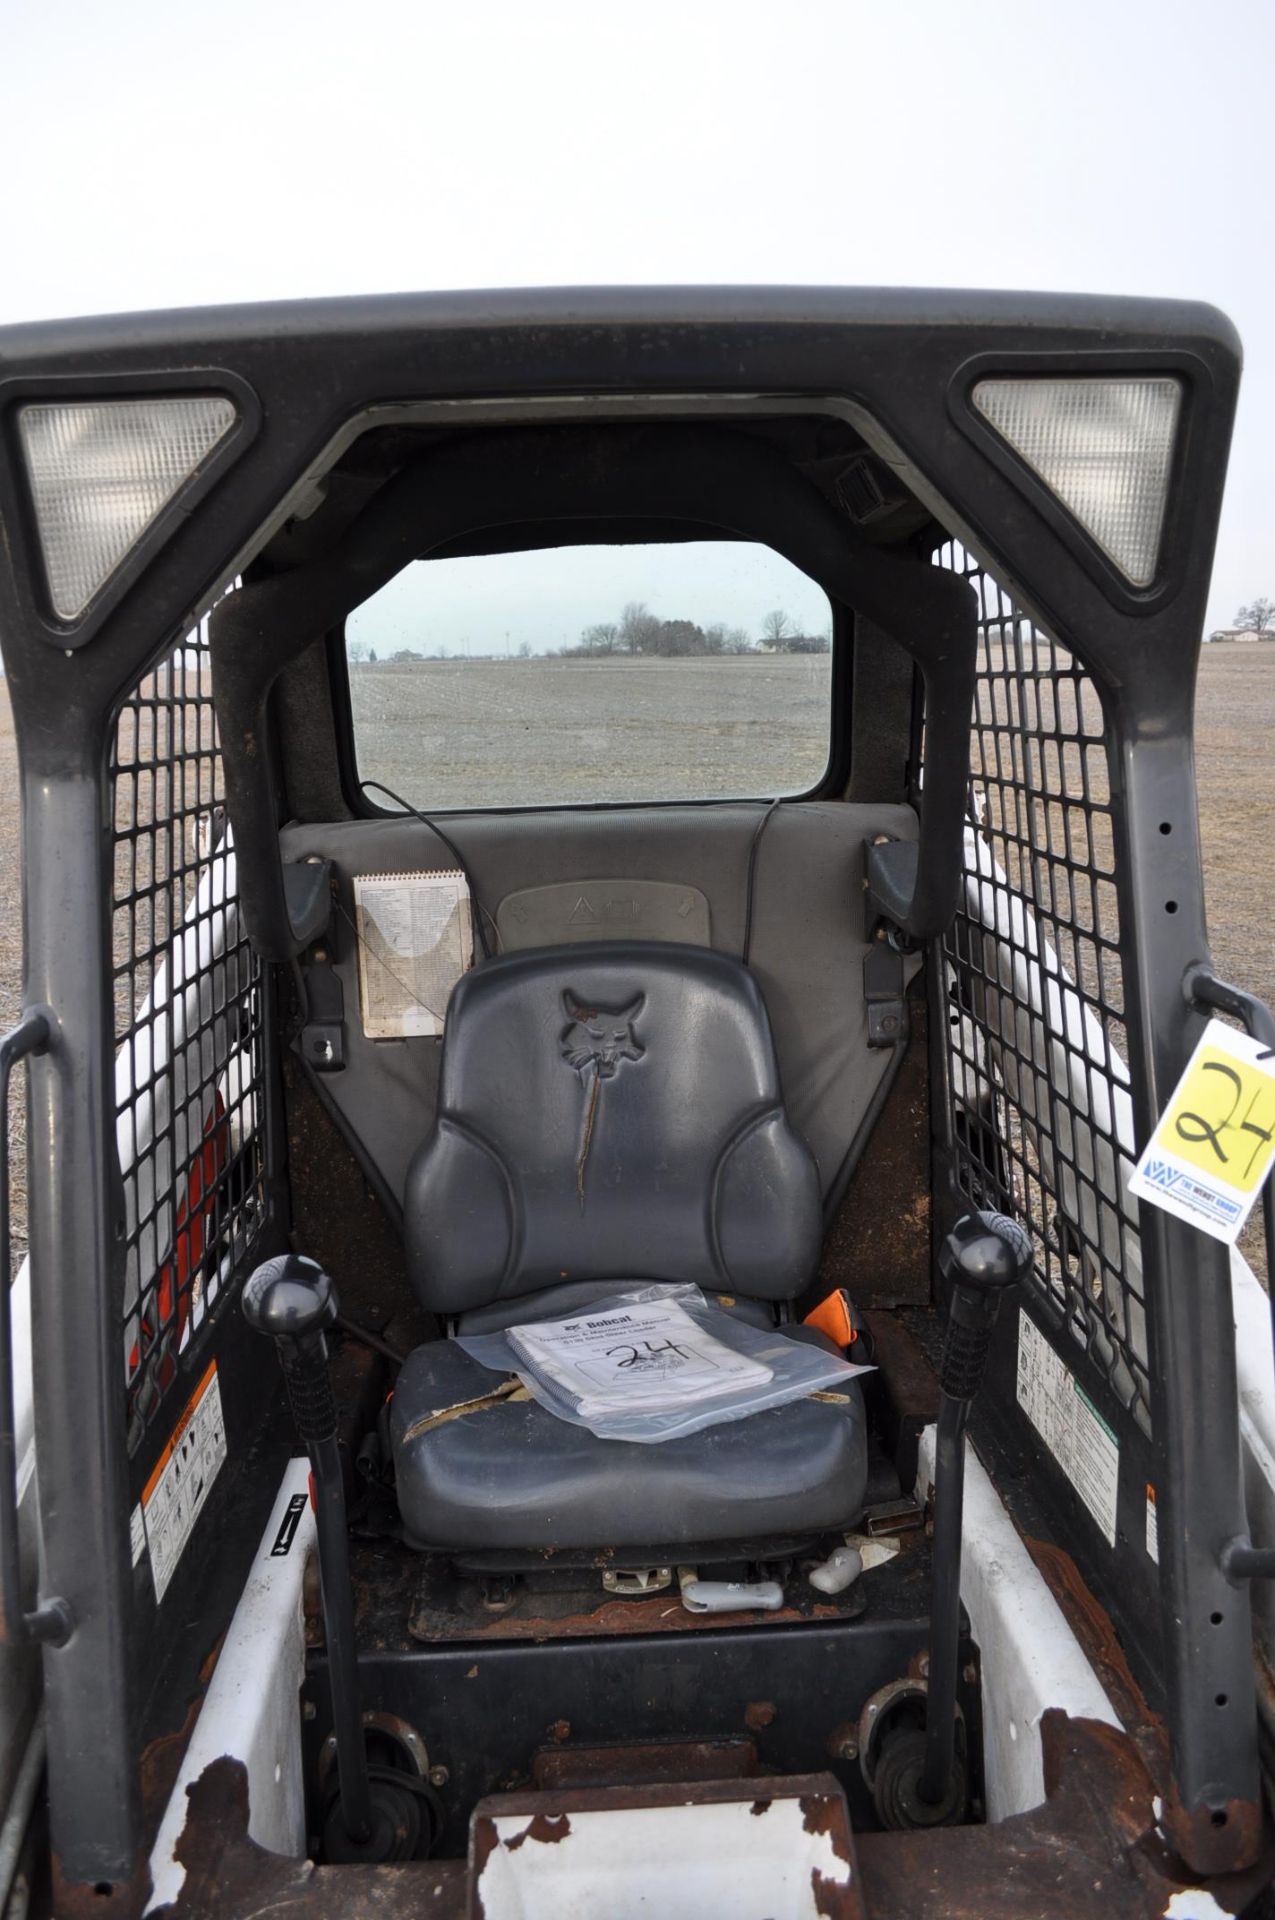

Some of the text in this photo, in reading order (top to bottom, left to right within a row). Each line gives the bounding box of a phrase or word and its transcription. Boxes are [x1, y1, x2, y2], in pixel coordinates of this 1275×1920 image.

[1175, 1062, 1275, 1180] 24
[586, 1315, 632, 1329] Bobcat
[606, 1338, 689, 1368] 24
